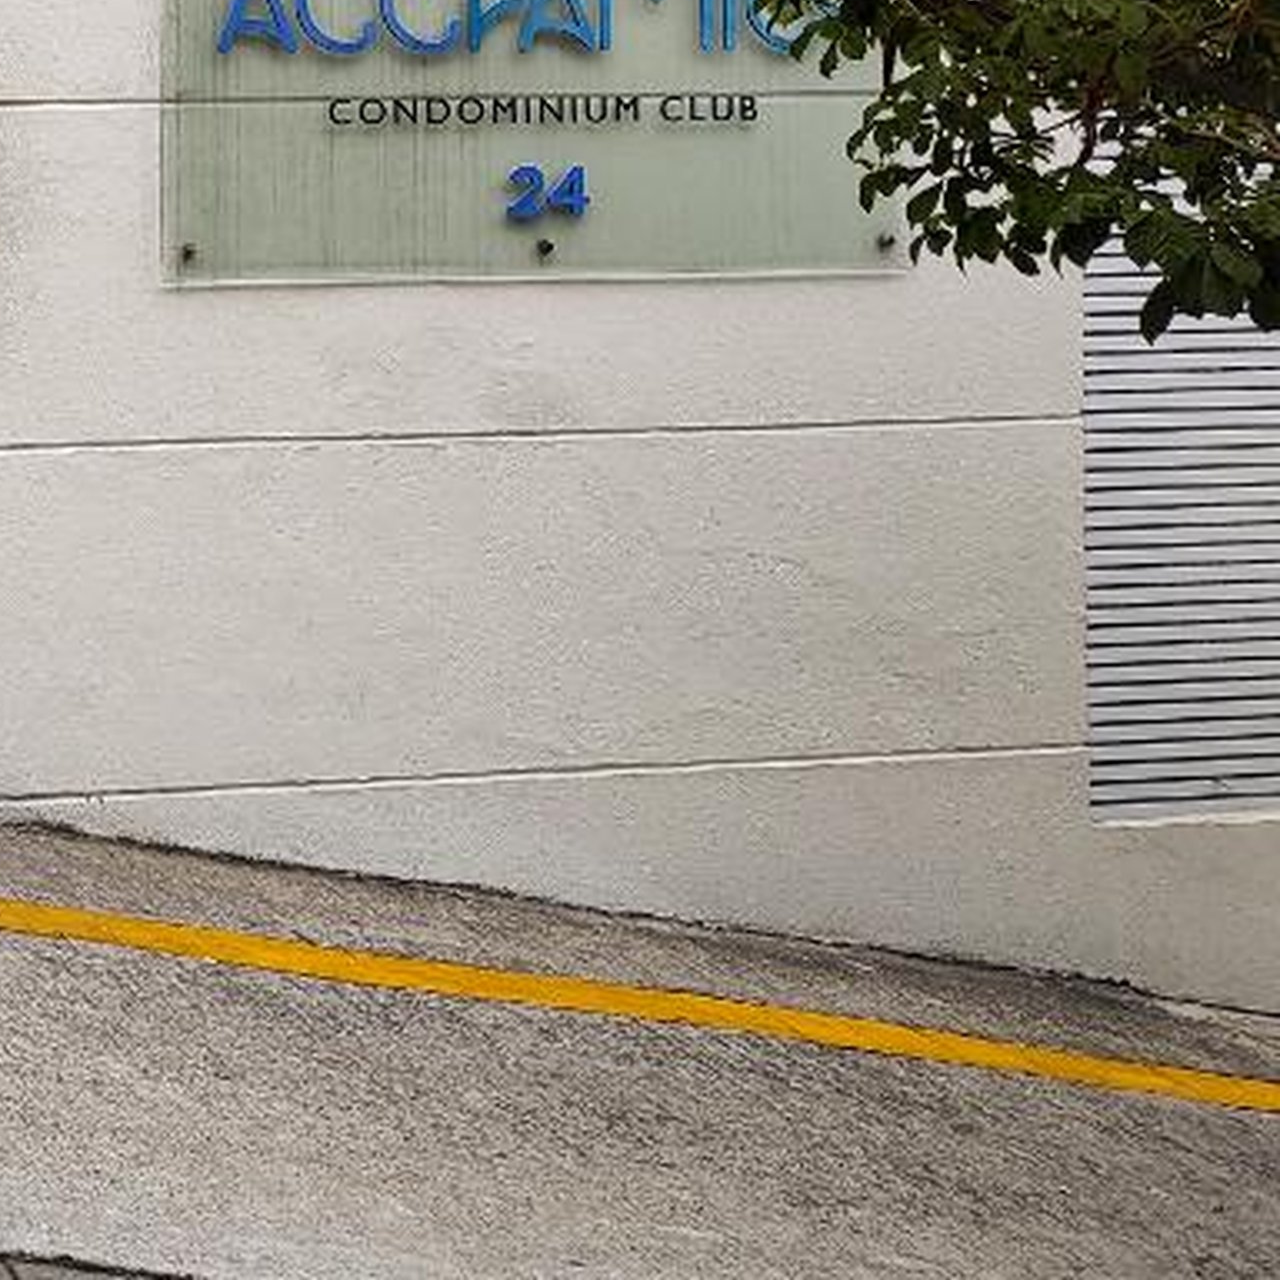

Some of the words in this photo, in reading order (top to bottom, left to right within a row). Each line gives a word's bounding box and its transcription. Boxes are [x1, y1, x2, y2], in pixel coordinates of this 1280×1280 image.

[329, 95, 640, 125] CONDOMINIUM
[659, 94, 759, 122] CLUB
[506, 165, 590, 217] 24
